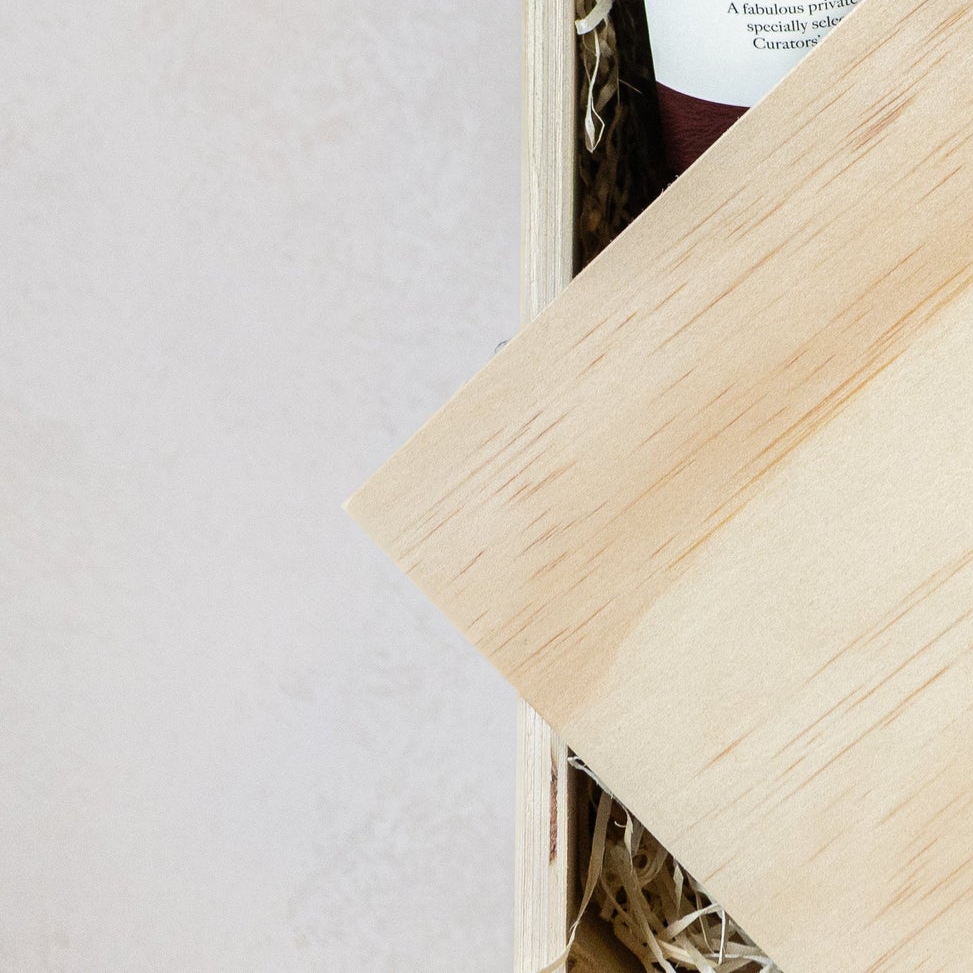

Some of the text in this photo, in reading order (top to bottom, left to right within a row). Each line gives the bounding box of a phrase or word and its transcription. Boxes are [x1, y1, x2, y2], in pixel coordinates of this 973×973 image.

[727, 2, 739, 14] A
[743, 2, 804, 15] fabulous
[747, 18, 808, 35] specially
